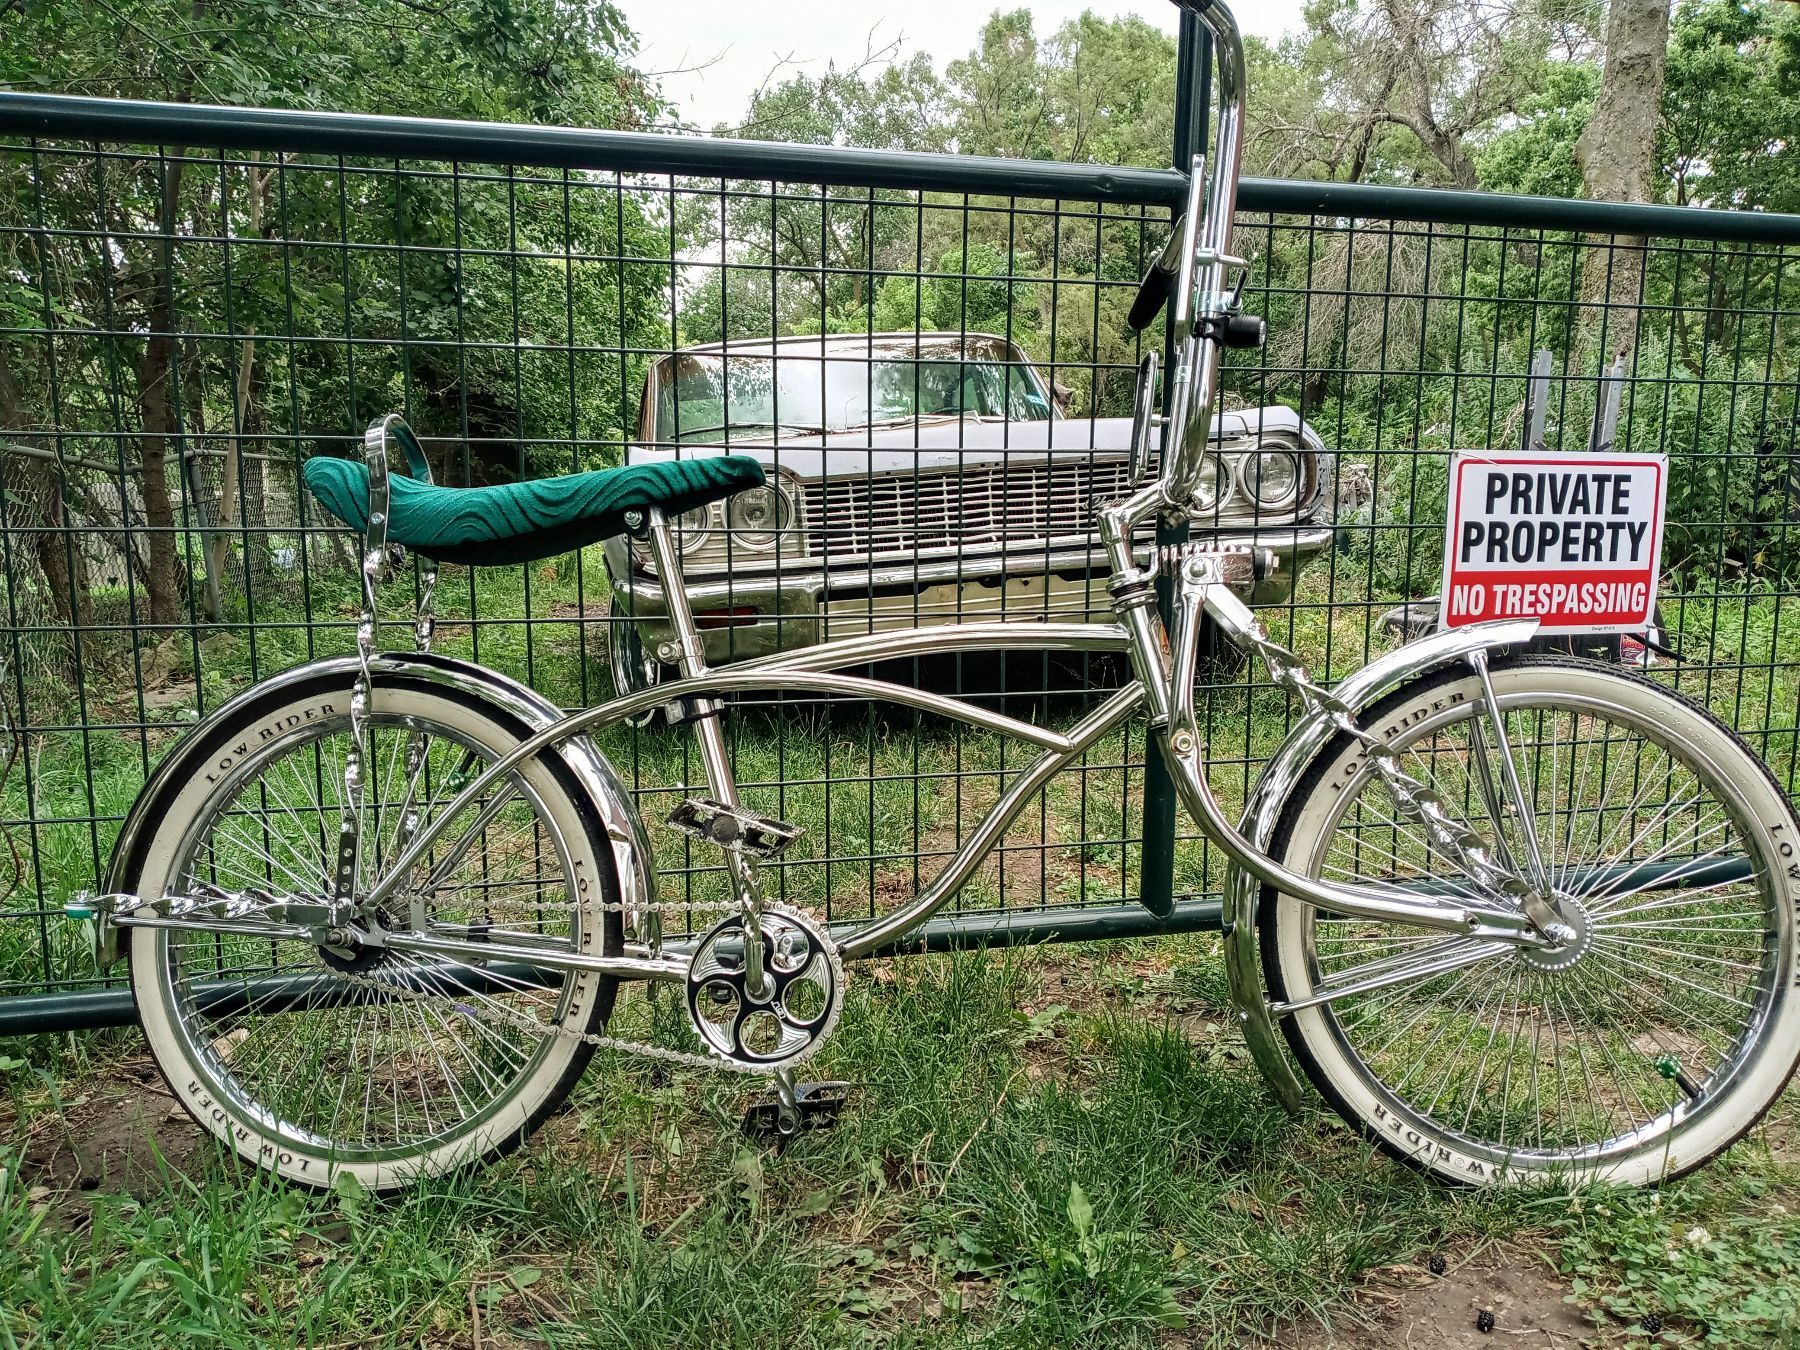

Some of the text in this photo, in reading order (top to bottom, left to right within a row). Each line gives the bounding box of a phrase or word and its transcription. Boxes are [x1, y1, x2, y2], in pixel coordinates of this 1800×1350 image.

[1485, 472, 1632, 515] PRIVATE
[1461, 520, 1648, 563] PROPERTY
[1451, 582, 1646, 616] NO TRESPASSING
[1383, 692, 1465, 740] RIDER
[205, 704, 335, 783] LOW RIDER
[1769, 822, 1800, 880] LOW
[1373, 1103, 1452, 1164] RIDER
[258, 1143, 312, 1172] LOW
